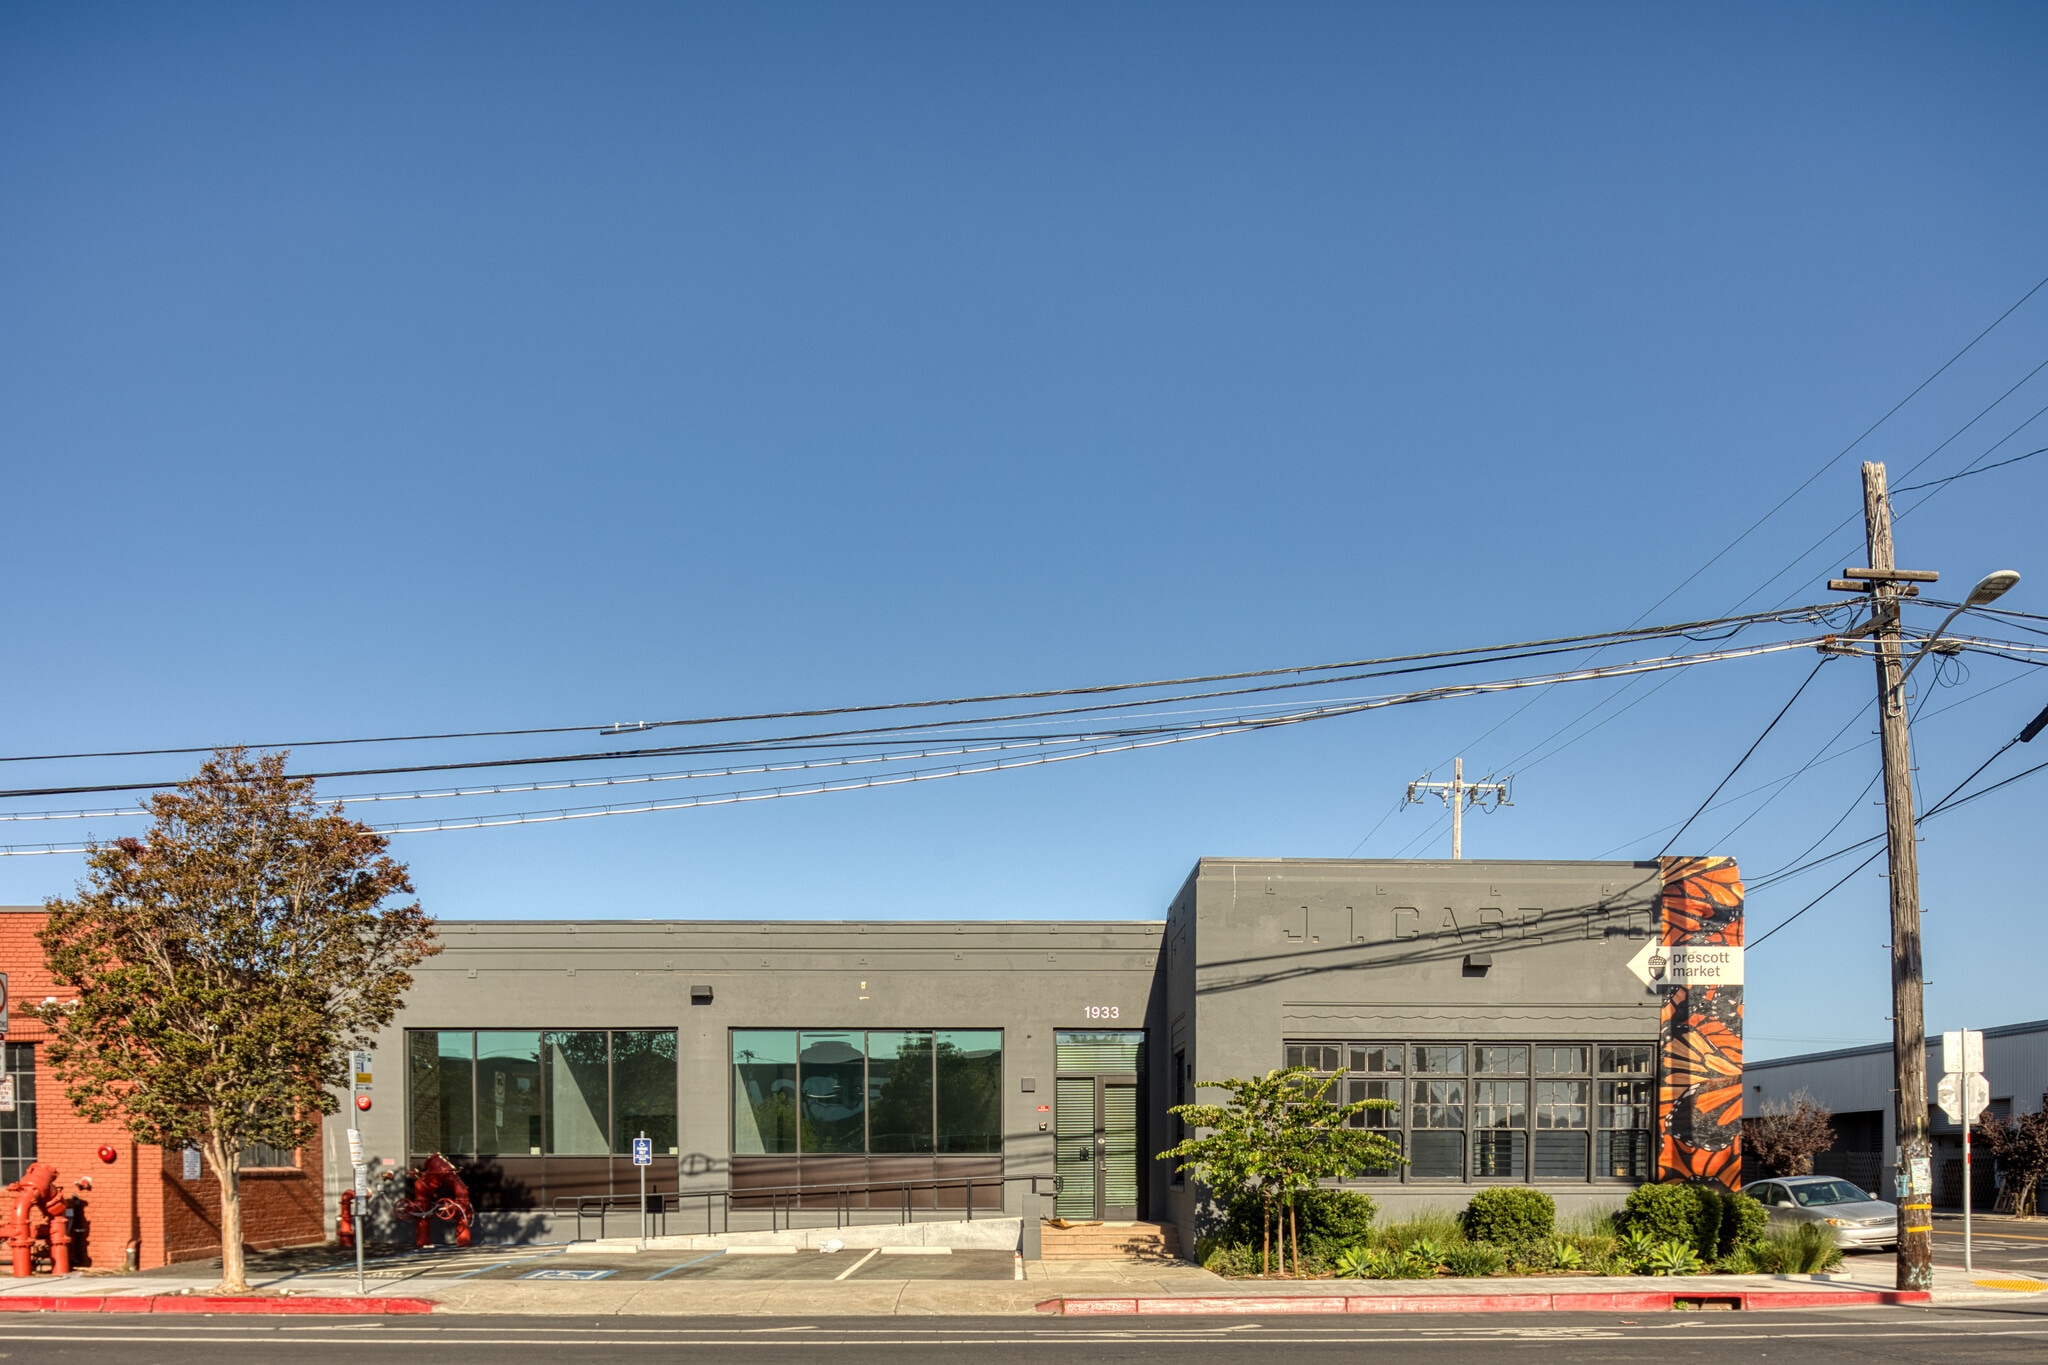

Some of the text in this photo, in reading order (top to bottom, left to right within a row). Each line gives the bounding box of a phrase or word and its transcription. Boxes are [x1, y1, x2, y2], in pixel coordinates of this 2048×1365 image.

[1391, 906, 1544, 945] CASE
[1673, 952, 1730, 965] prescott
[1673, 965, 1721, 977] market
[1084, 1006, 1119, 1019] 1933
